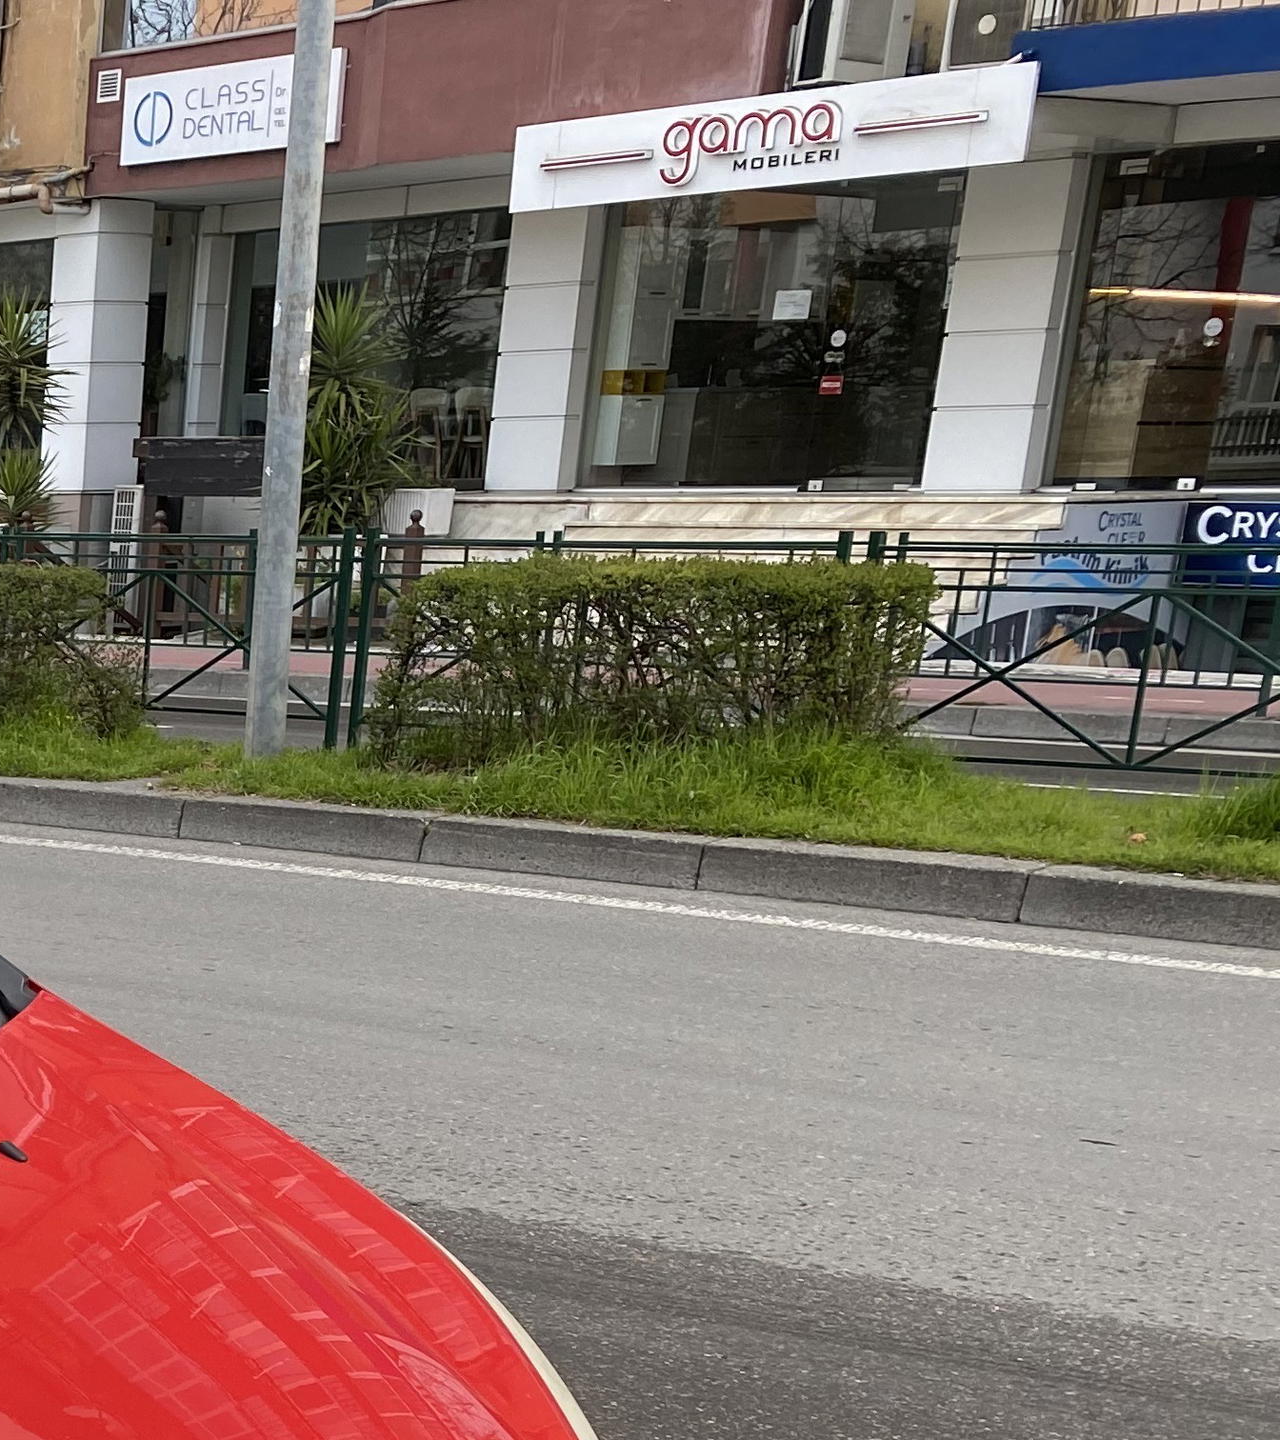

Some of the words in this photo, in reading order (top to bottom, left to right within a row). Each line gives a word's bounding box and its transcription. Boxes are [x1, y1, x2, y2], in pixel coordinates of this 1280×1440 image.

[185, 79, 267, 110] CLASS
[183, 110, 265, 139] DENTAL
[659, 101, 843, 187] gama
[733, 148, 840, 172] MOBILERI
[1099, 510, 1143, 531] CRYSTAL
[1198, 505, 1280, 544] CRY
